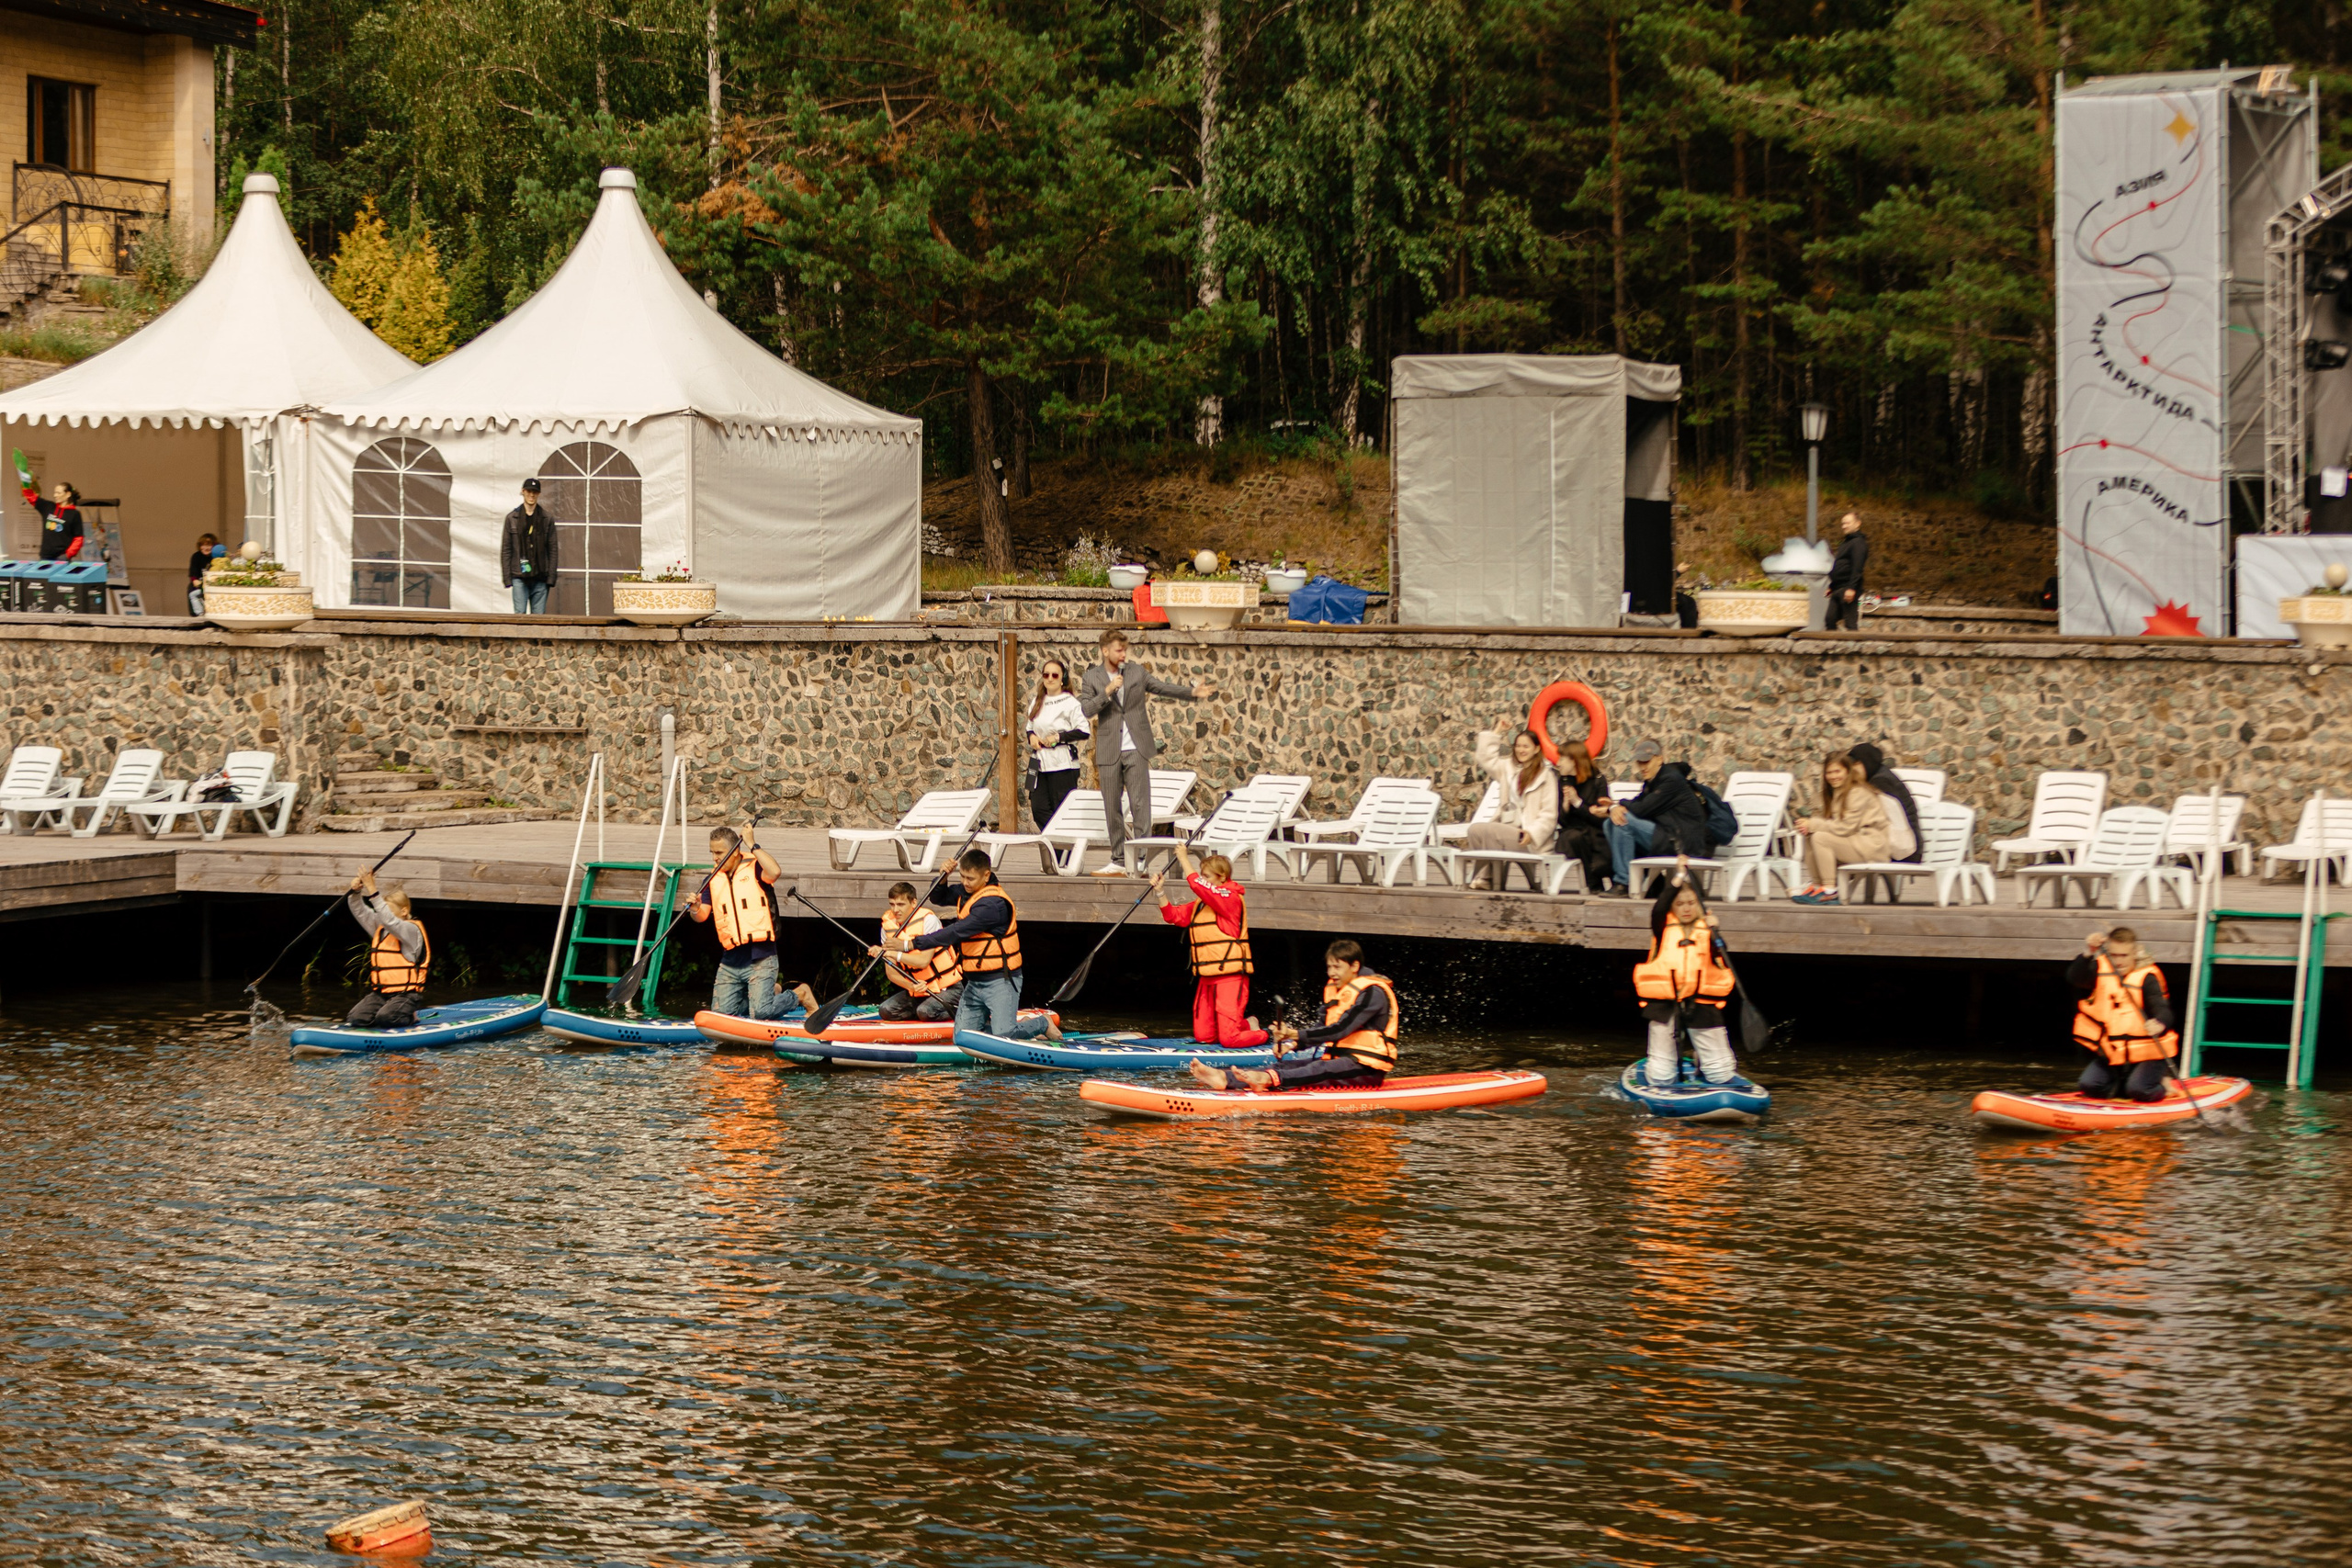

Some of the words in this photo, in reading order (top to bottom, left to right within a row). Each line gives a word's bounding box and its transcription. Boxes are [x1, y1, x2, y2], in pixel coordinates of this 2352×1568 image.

[2114, 169, 2165, 199] АЗИЯ
[2089, 312, 2195, 422] АНТАРКТИДА
[2097, 476, 2189, 524] АМЕРИКА
[902, 1032, 943, 1040] Feath-R-Lite
